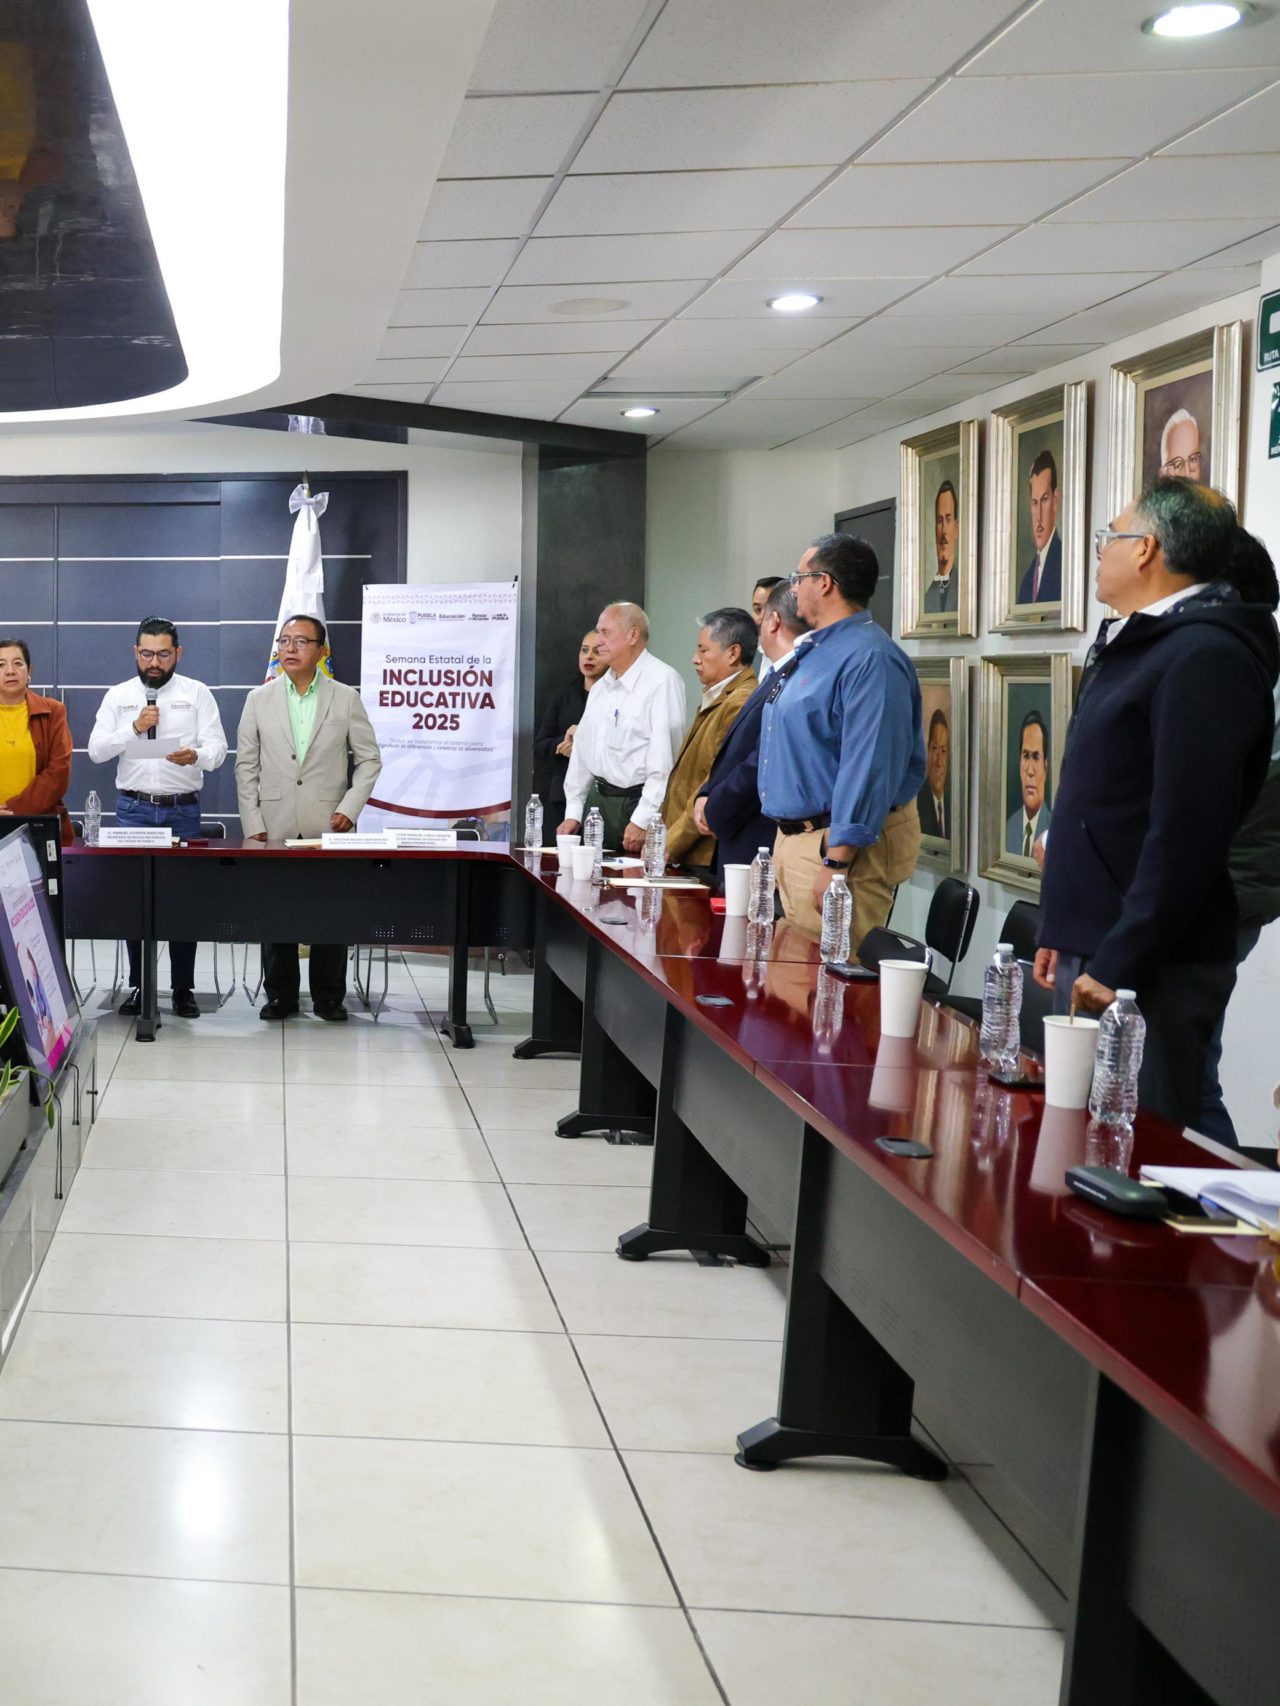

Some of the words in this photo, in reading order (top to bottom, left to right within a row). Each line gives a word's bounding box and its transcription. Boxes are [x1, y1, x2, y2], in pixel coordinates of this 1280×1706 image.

[1264, 348, 1279, 362] RUTA
[386, 654, 426, 664] Semana
[428, 655, 464, 664] Estatal
[467, 655, 480, 664] de
[482, 655, 492, 664] la
[382, 665, 493, 687] INCLUSIÓN
[379, 690, 496, 709] EDUCATIVA
[412, 713, 460, 731] 2025
